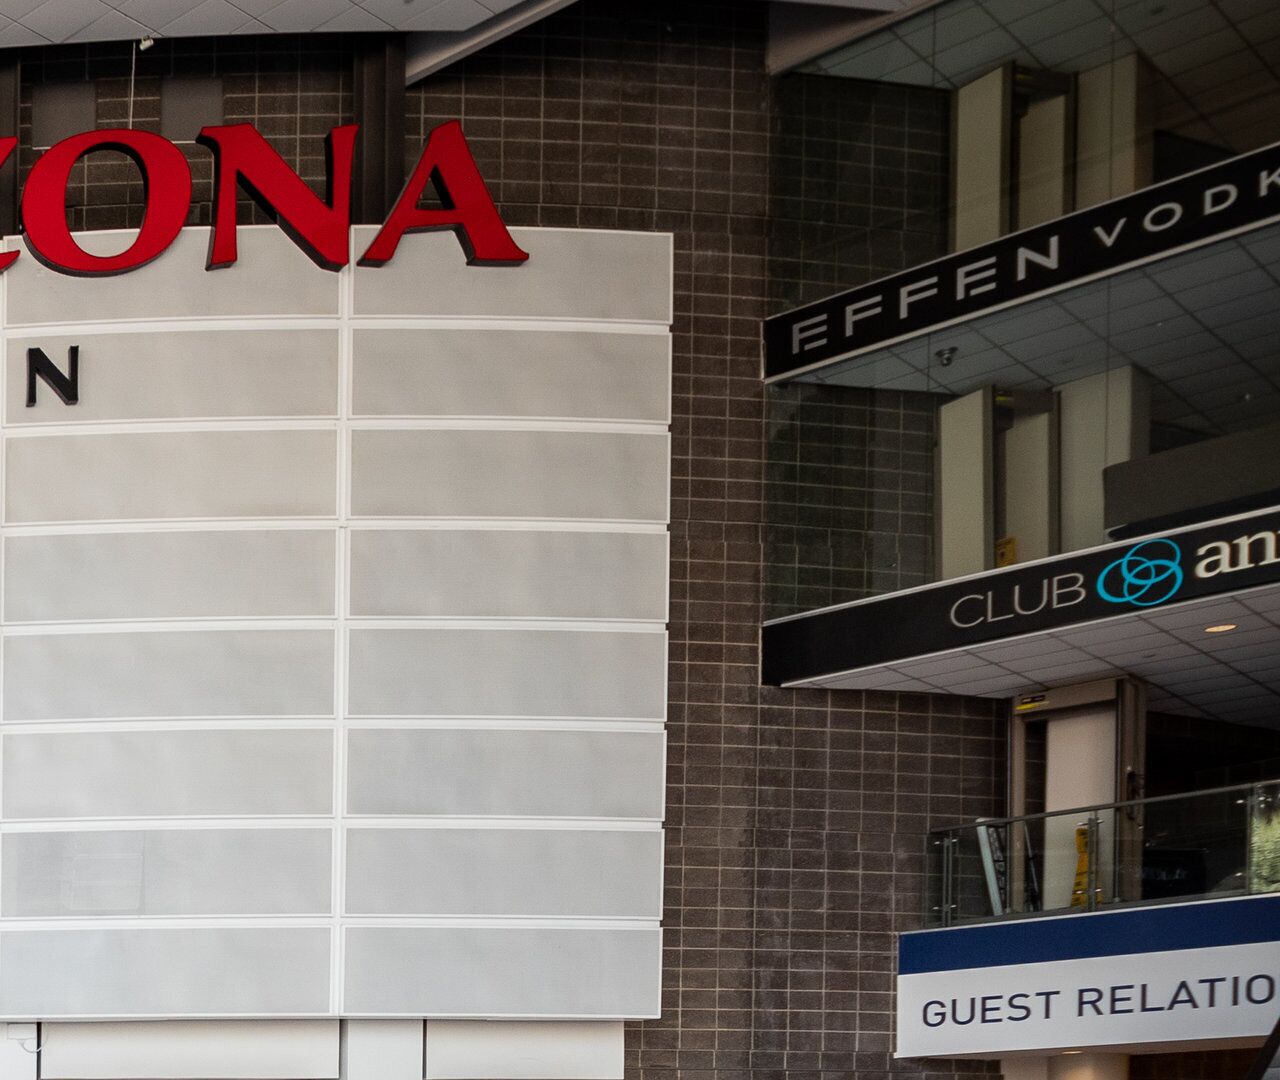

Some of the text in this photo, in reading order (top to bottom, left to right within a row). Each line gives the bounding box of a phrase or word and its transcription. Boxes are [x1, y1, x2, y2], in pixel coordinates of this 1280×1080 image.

[791, 167, 1280, 356] EFFEN VODK
[949, 529, 1280, 629] CLUB an
[922, 973, 1276, 1028] GUEST RELATIO
